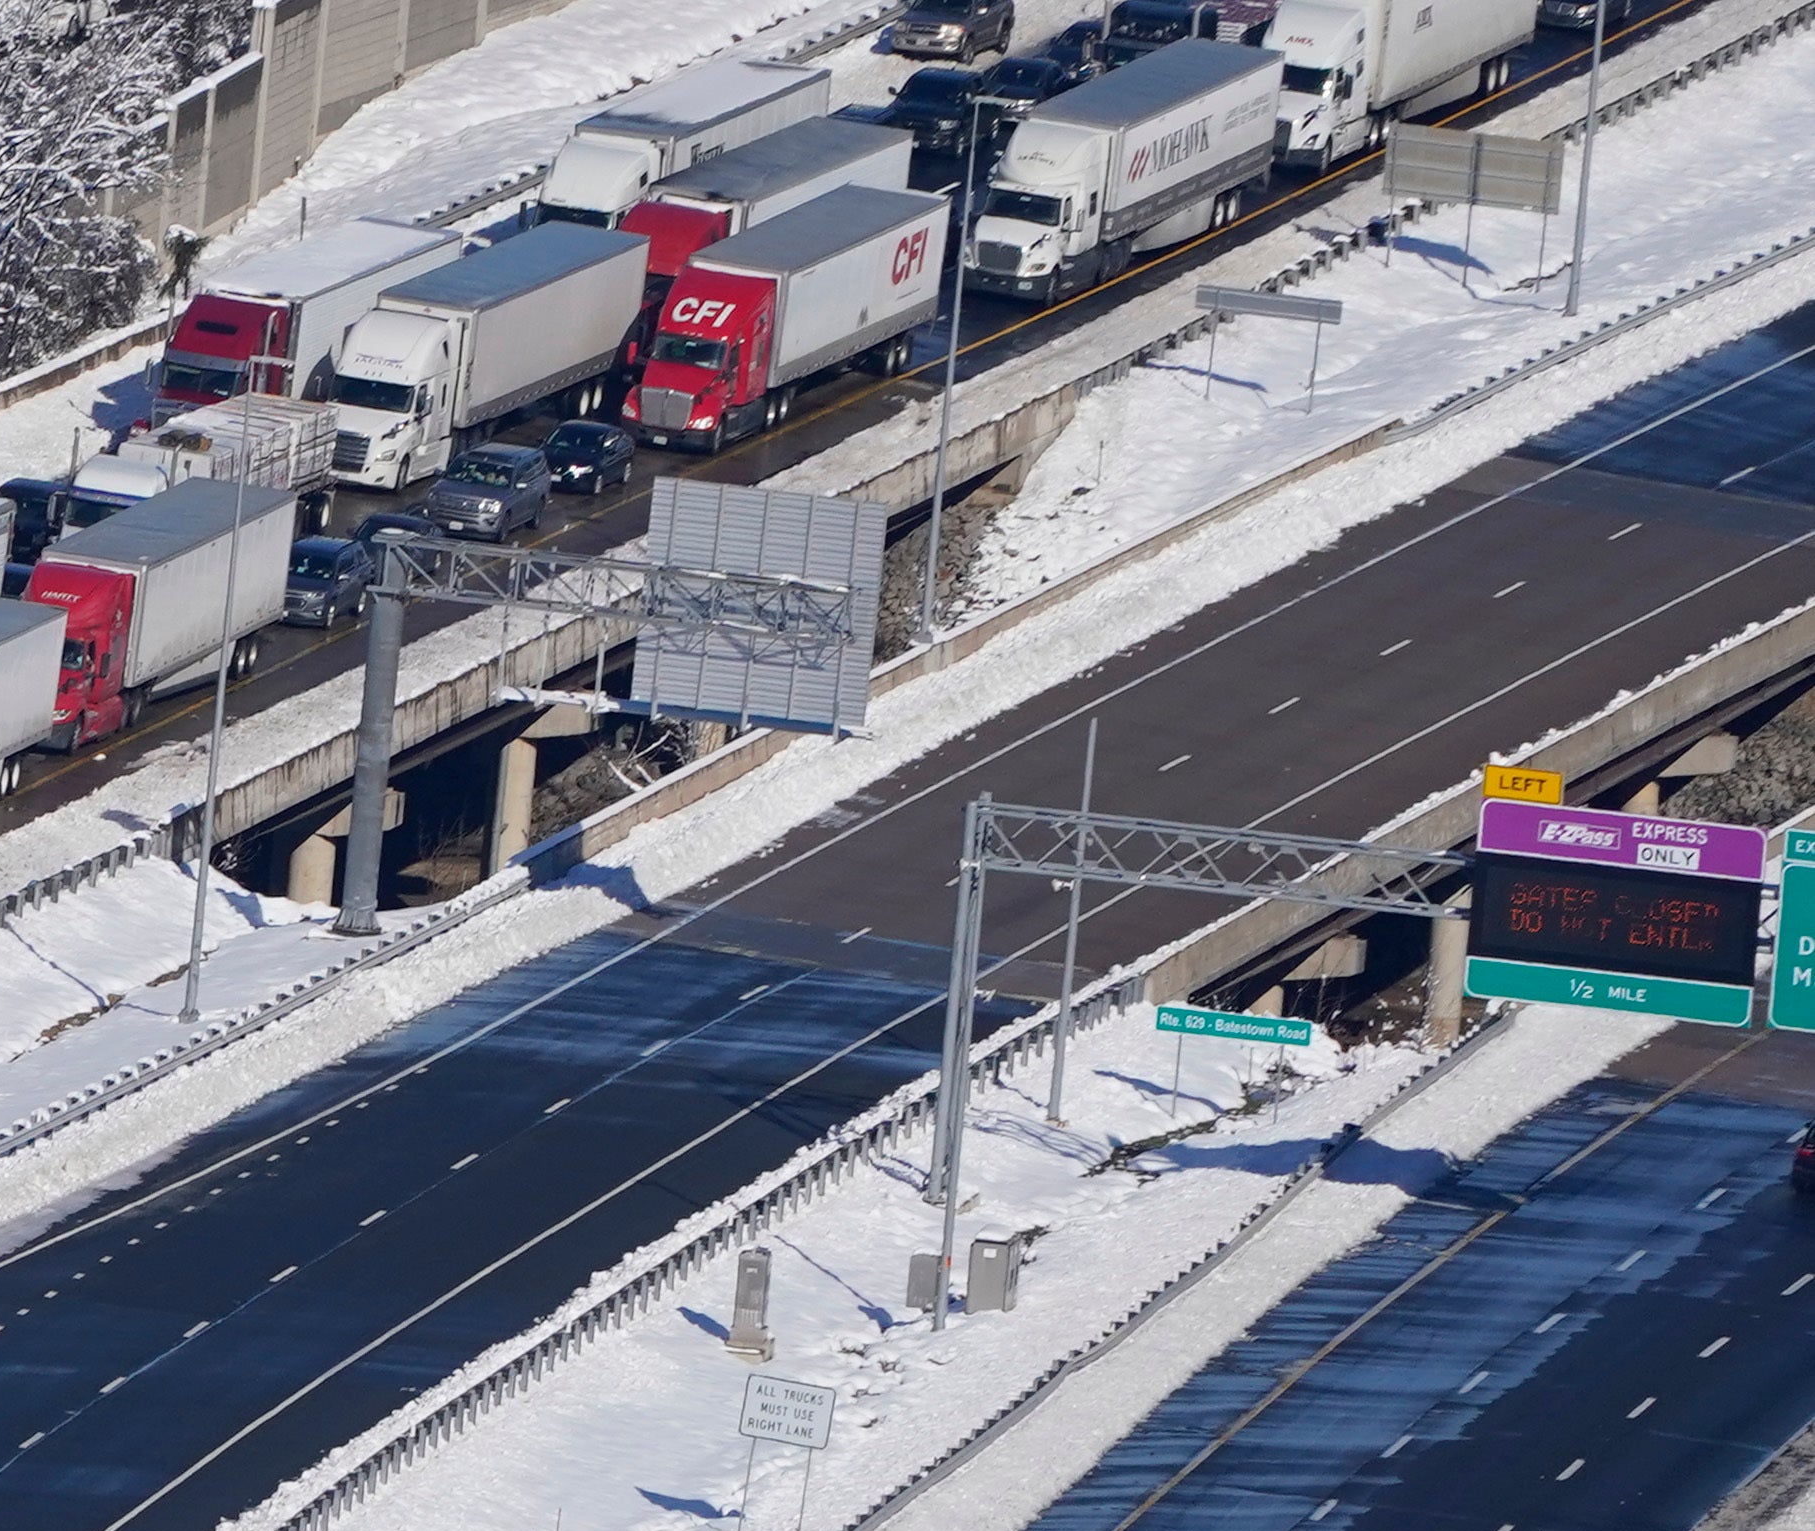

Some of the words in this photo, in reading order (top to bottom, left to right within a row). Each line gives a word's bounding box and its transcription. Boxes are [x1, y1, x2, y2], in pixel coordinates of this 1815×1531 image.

[1148, 114, 1213, 176] MOHAWK
[892, 227, 930, 285] CFI
[671, 296, 737, 329] CFI
[1498, 775, 1547, 794] LEFT
[1631, 821, 1709, 845] EXPRESS
[1640, 847, 1697, 867] ONLY
[1608, 985, 1647, 1003] MILE
[1215, 1019, 1274, 1037] Batestown
[1278, 1025, 1307, 1041] Road
[756, 1385, 776, 1397] ALL
[784, 1389, 824, 1406] TRUCKS
[760, 1403, 788, 1416] MUST
[794, 1408, 815, 1421] USE
[748, 1417, 782, 1432] RIGHT
[785, 1425, 814, 1439] LANE
